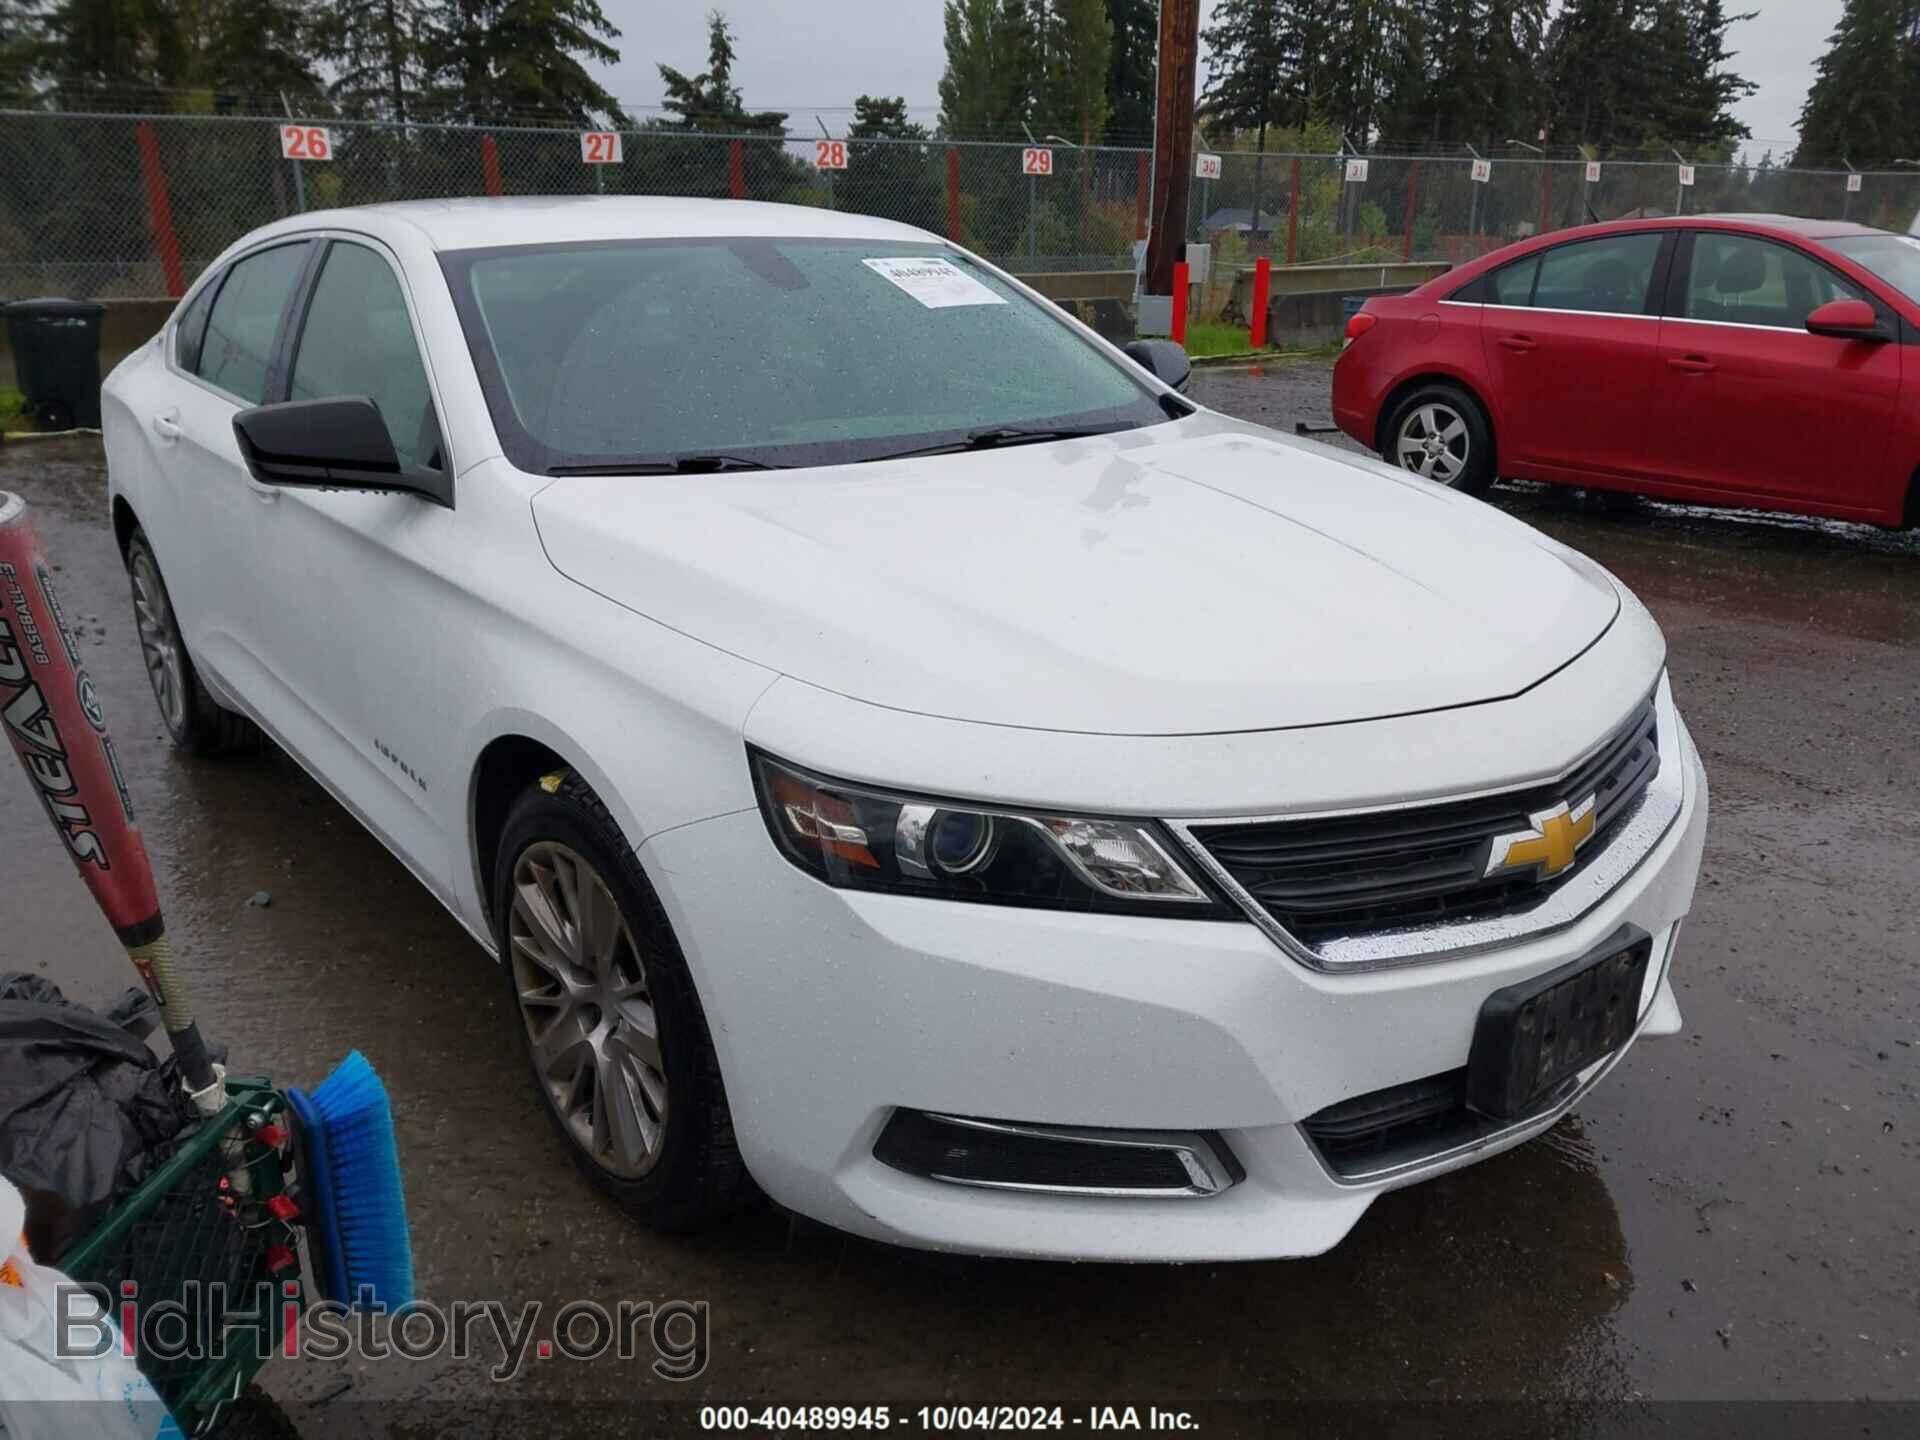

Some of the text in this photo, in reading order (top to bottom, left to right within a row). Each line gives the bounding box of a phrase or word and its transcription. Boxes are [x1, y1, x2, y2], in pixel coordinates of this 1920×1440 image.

[284, 126, 327, 158] 26
[586, 134, 615, 161] 27
[816, 141, 845, 168] 28
[1025, 150, 1051, 173] 29
[1202, 160, 1216, 174] 30
[8, 585, 50, 666] BASEBALL
[0, 617, 111, 871] STEAL
